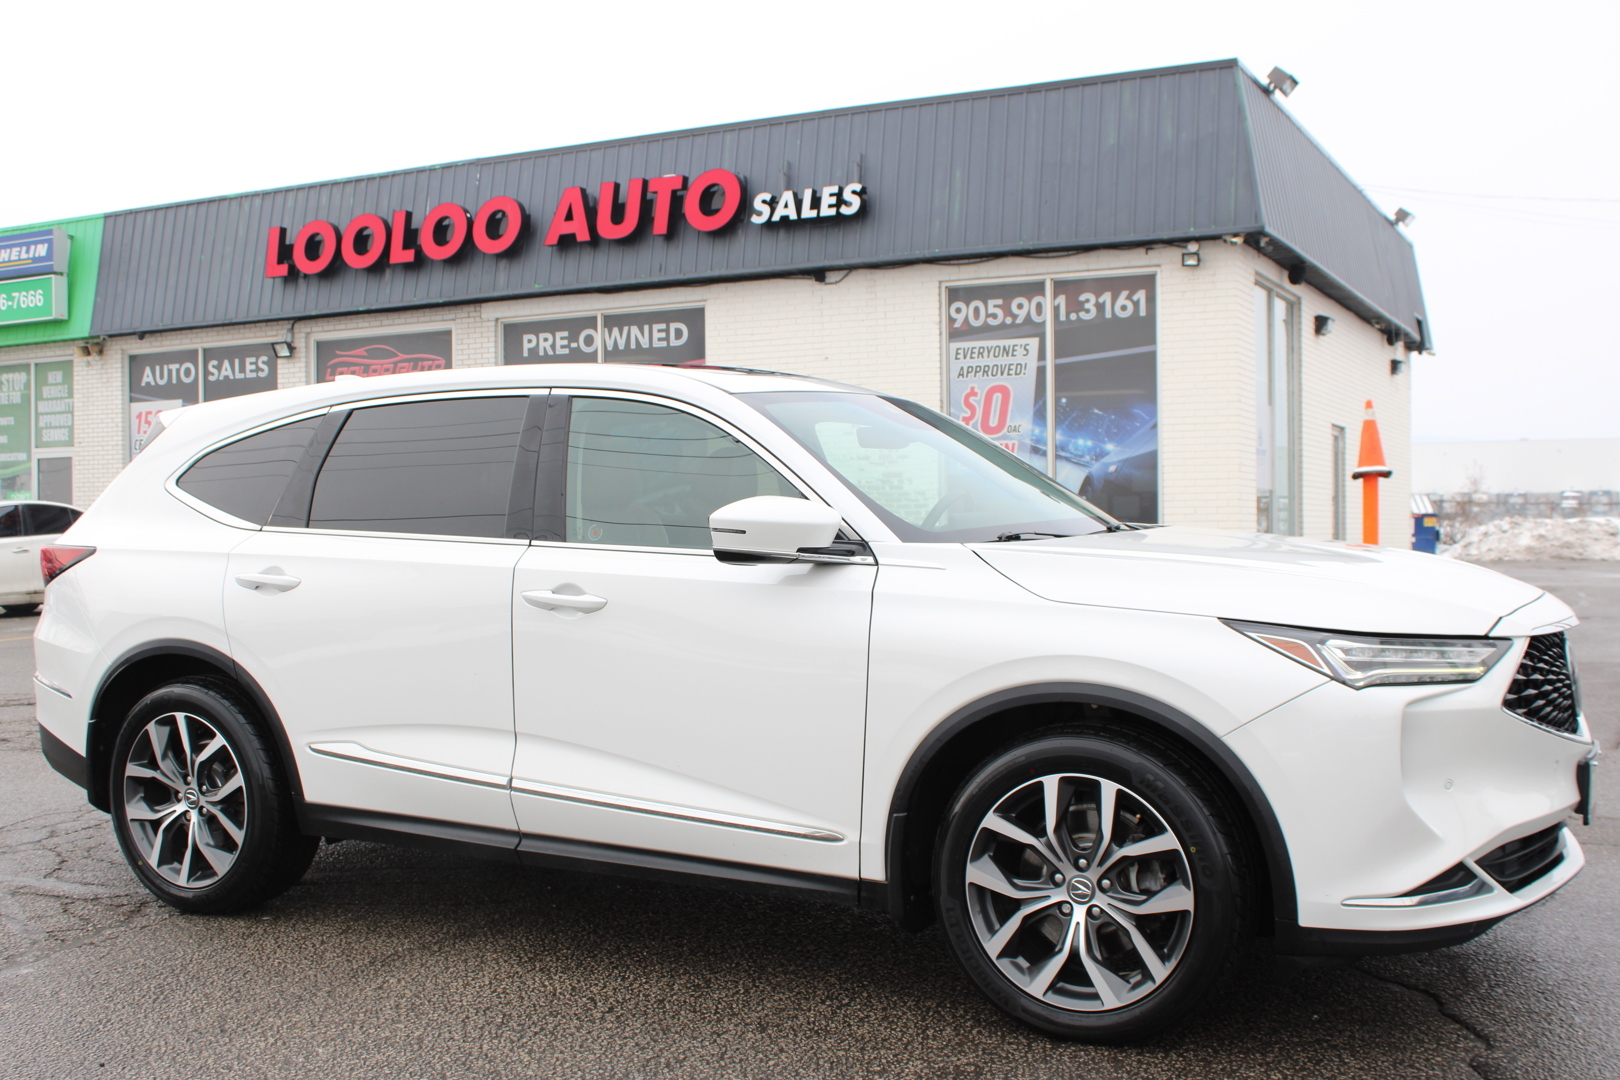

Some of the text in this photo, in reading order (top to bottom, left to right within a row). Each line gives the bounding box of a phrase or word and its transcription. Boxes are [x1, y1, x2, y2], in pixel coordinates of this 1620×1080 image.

[265, 169, 863, 278] LOOLOO AUTO SALES
[949, 289, 1147, 328] 905.901.3161
[522, 322, 689, 357] PRE-OWNED
[954, 343, 1030, 361] EVERYONE'S
[1, 371, 27, 391] STOP
[141, 356, 269, 387] AUTO SALES
[957, 363, 1027, 379] APPROVED!
[961, 384, 1012, 436] $0
